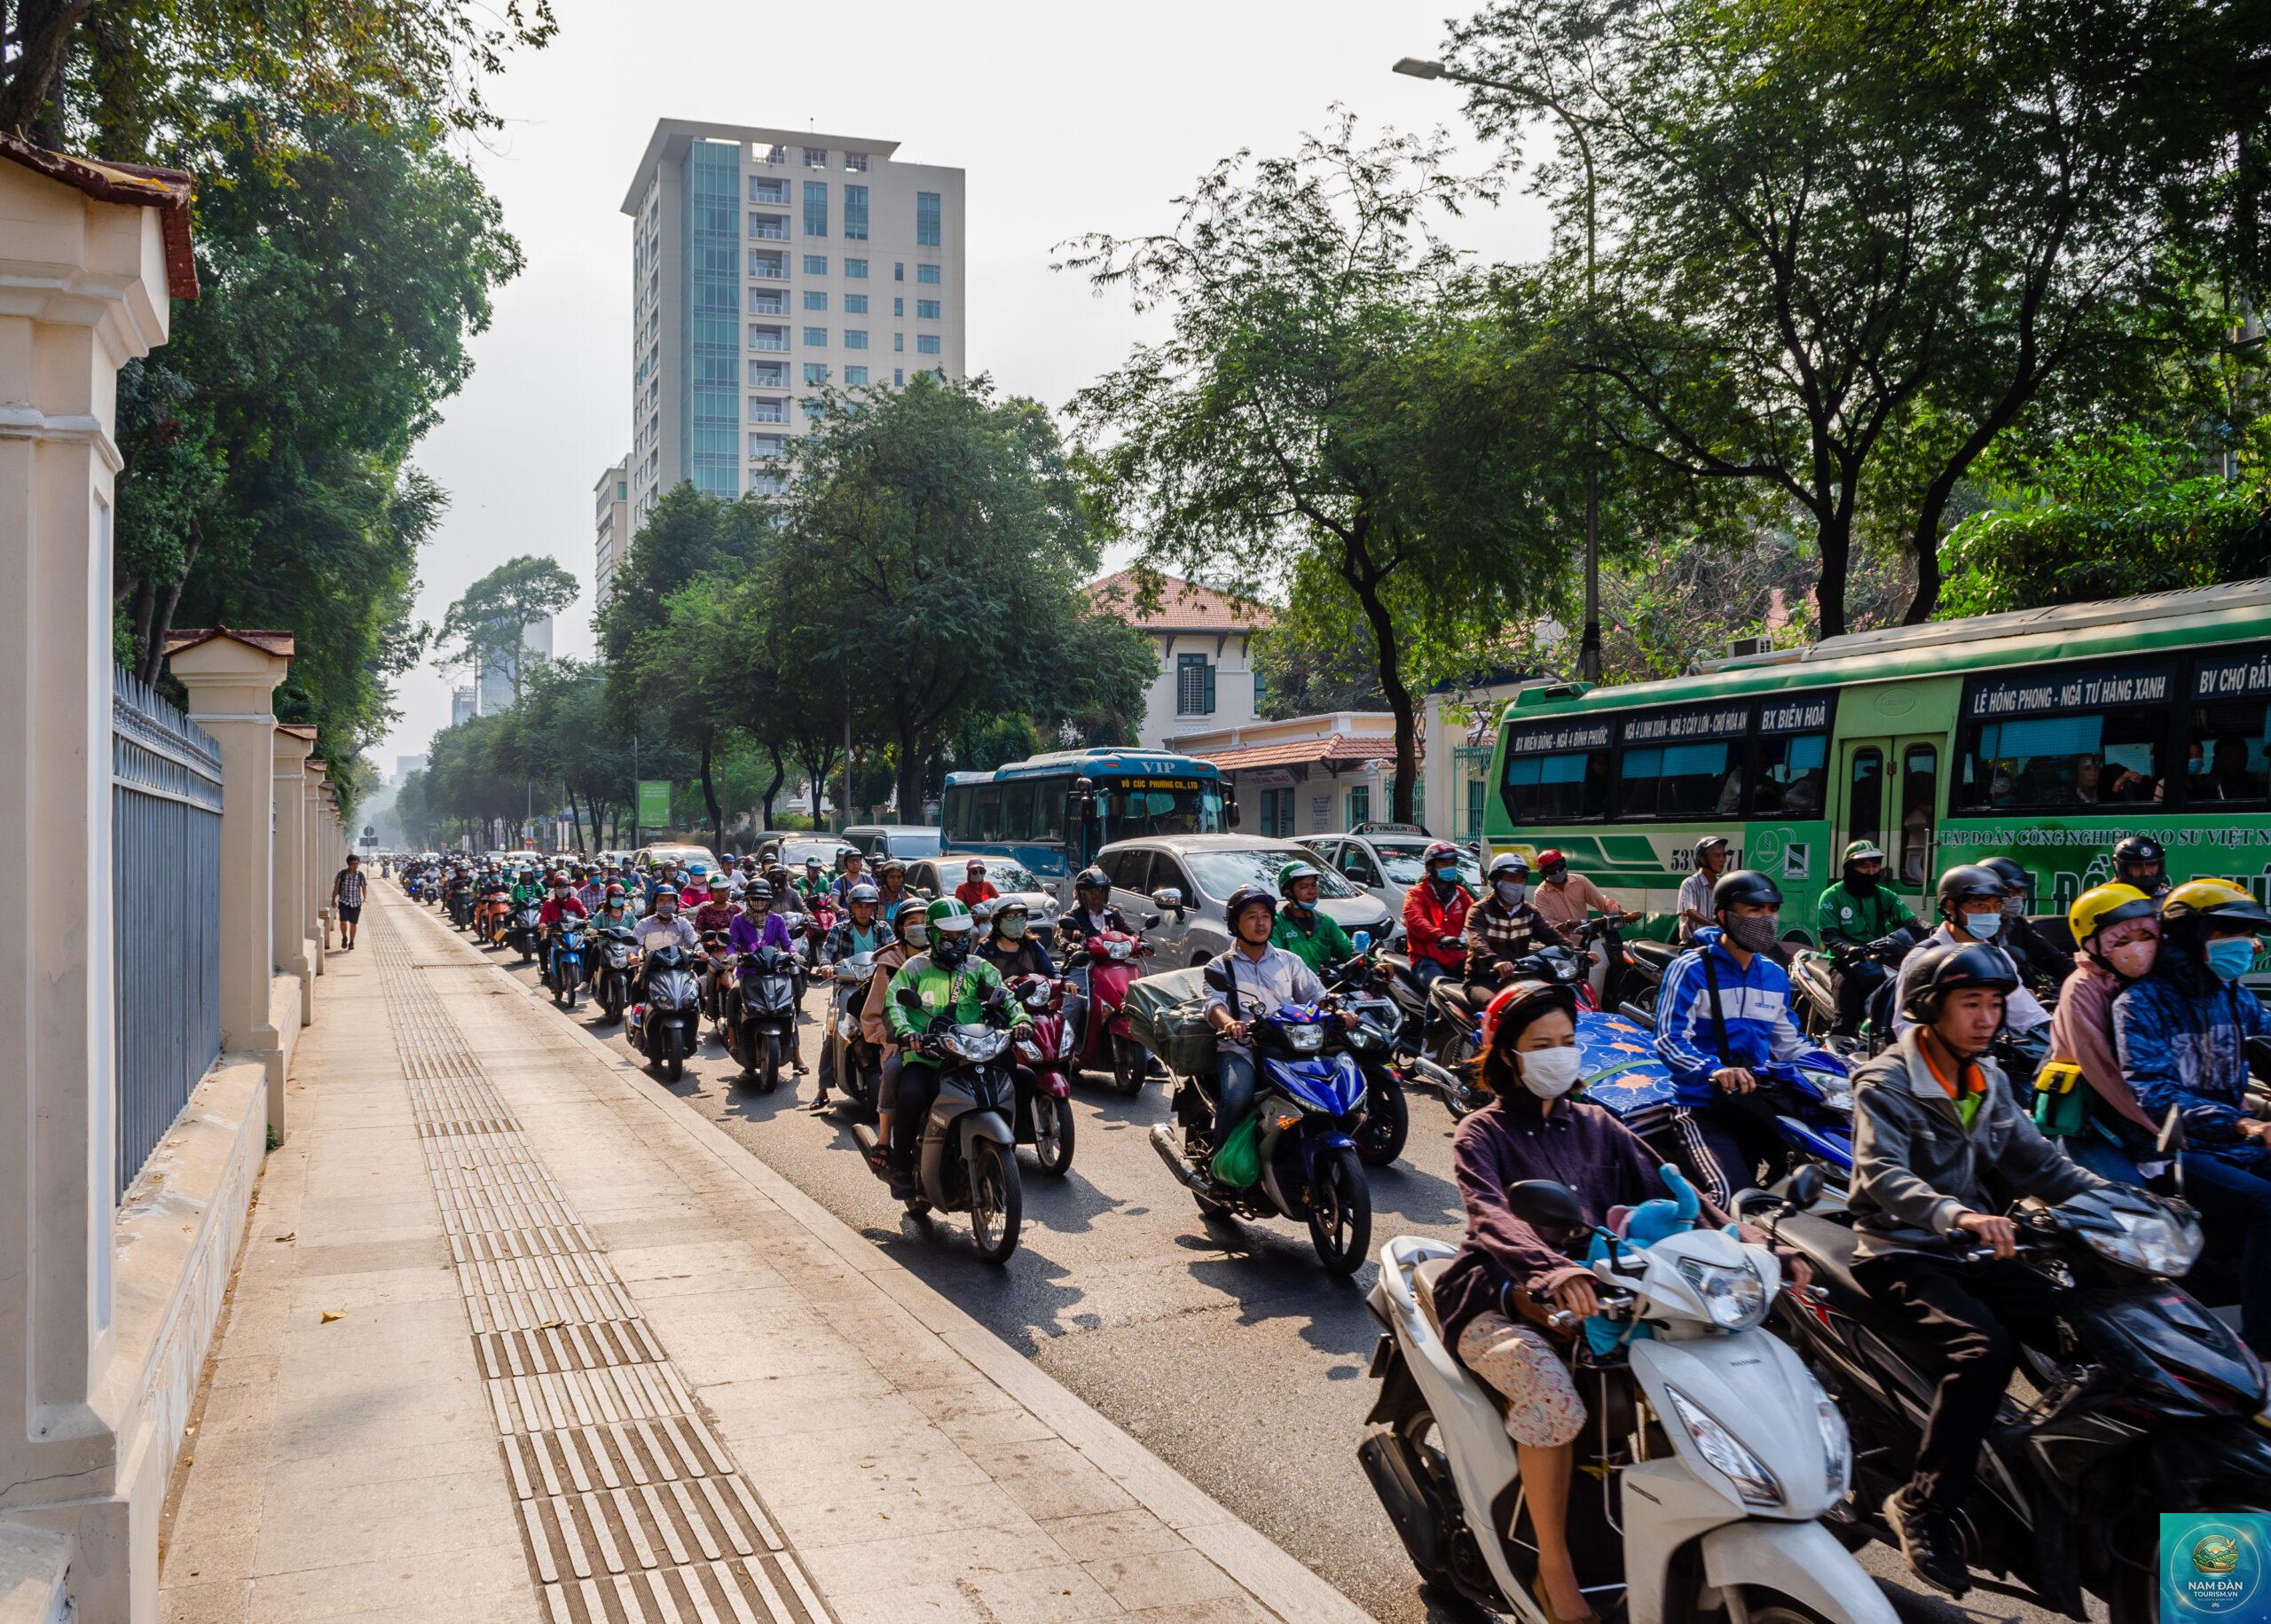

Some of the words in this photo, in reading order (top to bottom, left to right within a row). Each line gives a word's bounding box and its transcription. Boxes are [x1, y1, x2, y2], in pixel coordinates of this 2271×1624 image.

[2199, 670, 2218, 693] BV
[2220, 663, 2247, 694] CHỢ
[1973, 688, 1987, 714] LÊ
[1989, 682, 2016, 712] HỒNG
[2017, 686, 2053, 710] PHONG
[2060, 679, 2082, 707] NGÃ
[2085, 679, 2102, 704] TƯ
[2102, 675, 2133, 703] HÀNG
[2133, 677, 2166, 700] XANH
[1681, 718, 1687, 734] 3
[1762, 710, 1777, 730] BX
[1778, 702, 1803, 728] BIÊN
[1804, 701, 1826, 727] HOÀ
[1515, 737, 1524, 752] BX
[1568, 733, 1574, 747] 4
[1142, 762, 1175, 773] VIP
[1187, 781, 1198, 789] LTD
[1941, 829, 1970, 848] TẬP
[1971, 826, 2015, 846] ĐOÀN
[2017, 827, 2064, 846] CÔNG
[2178, 829, 2204, 846] SU
[2205, 827, 2254, 850] VIỆT
